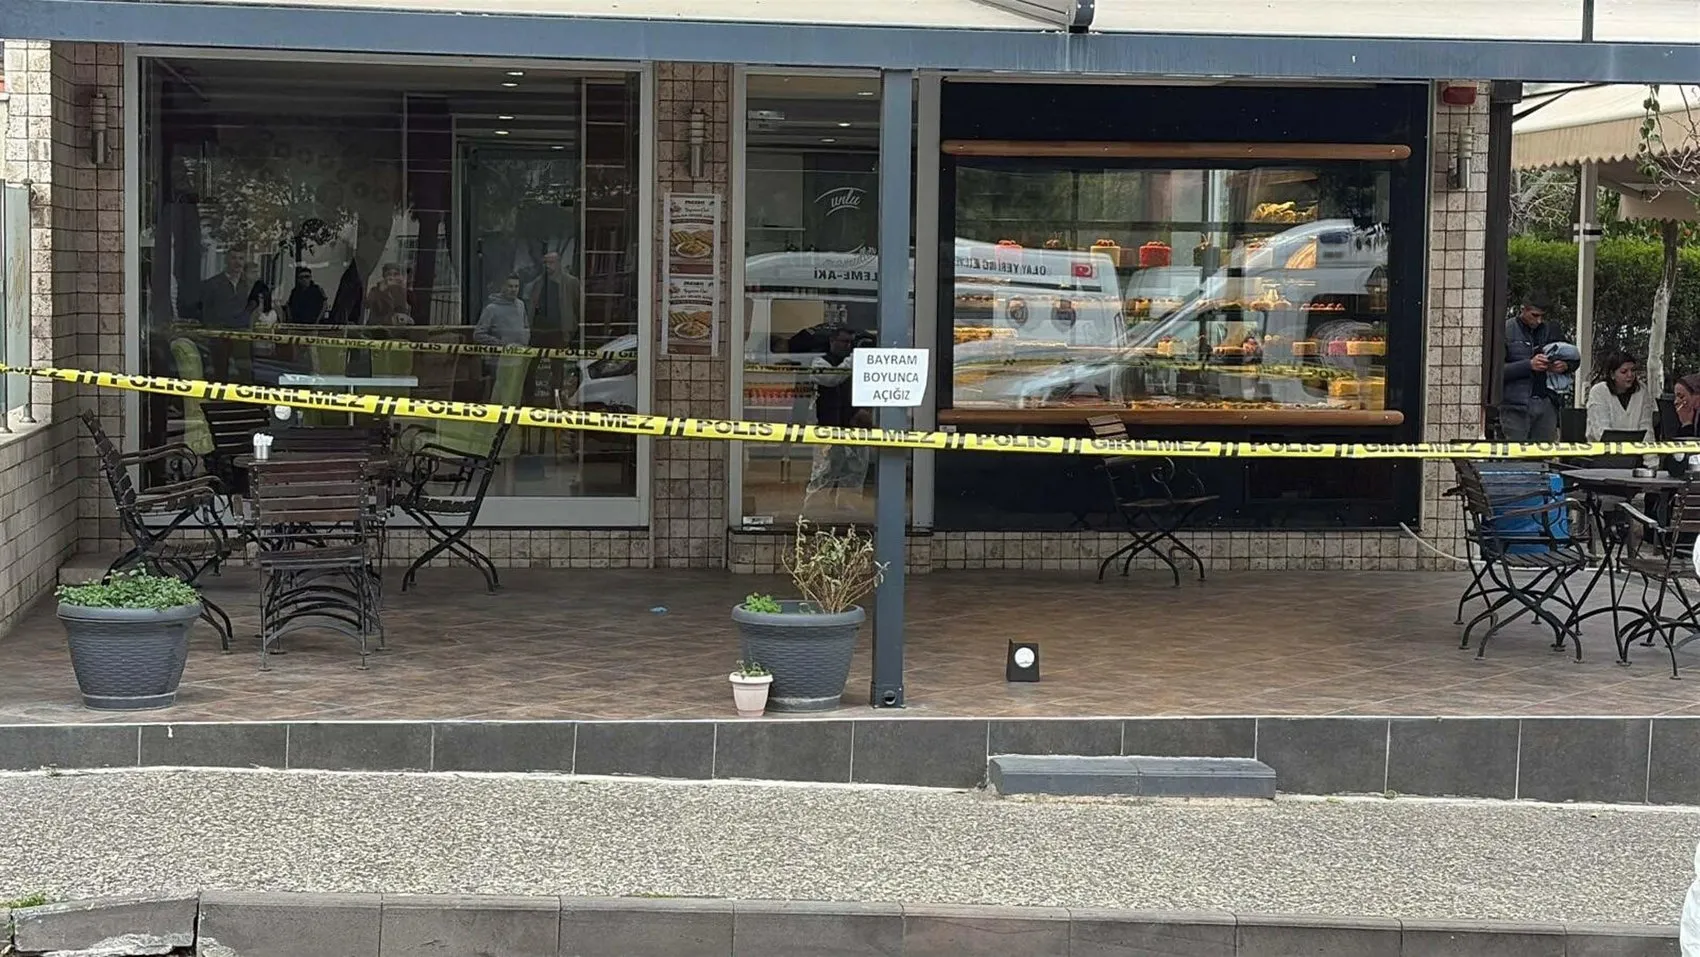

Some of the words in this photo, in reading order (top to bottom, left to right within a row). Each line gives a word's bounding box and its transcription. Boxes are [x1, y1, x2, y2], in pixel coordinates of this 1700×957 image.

[866, 354, 918, 365] BAYRAM
[863, 372, 919, 383] BOYUNCA
[872, 387, 911, 403] AÇIĞIZ
